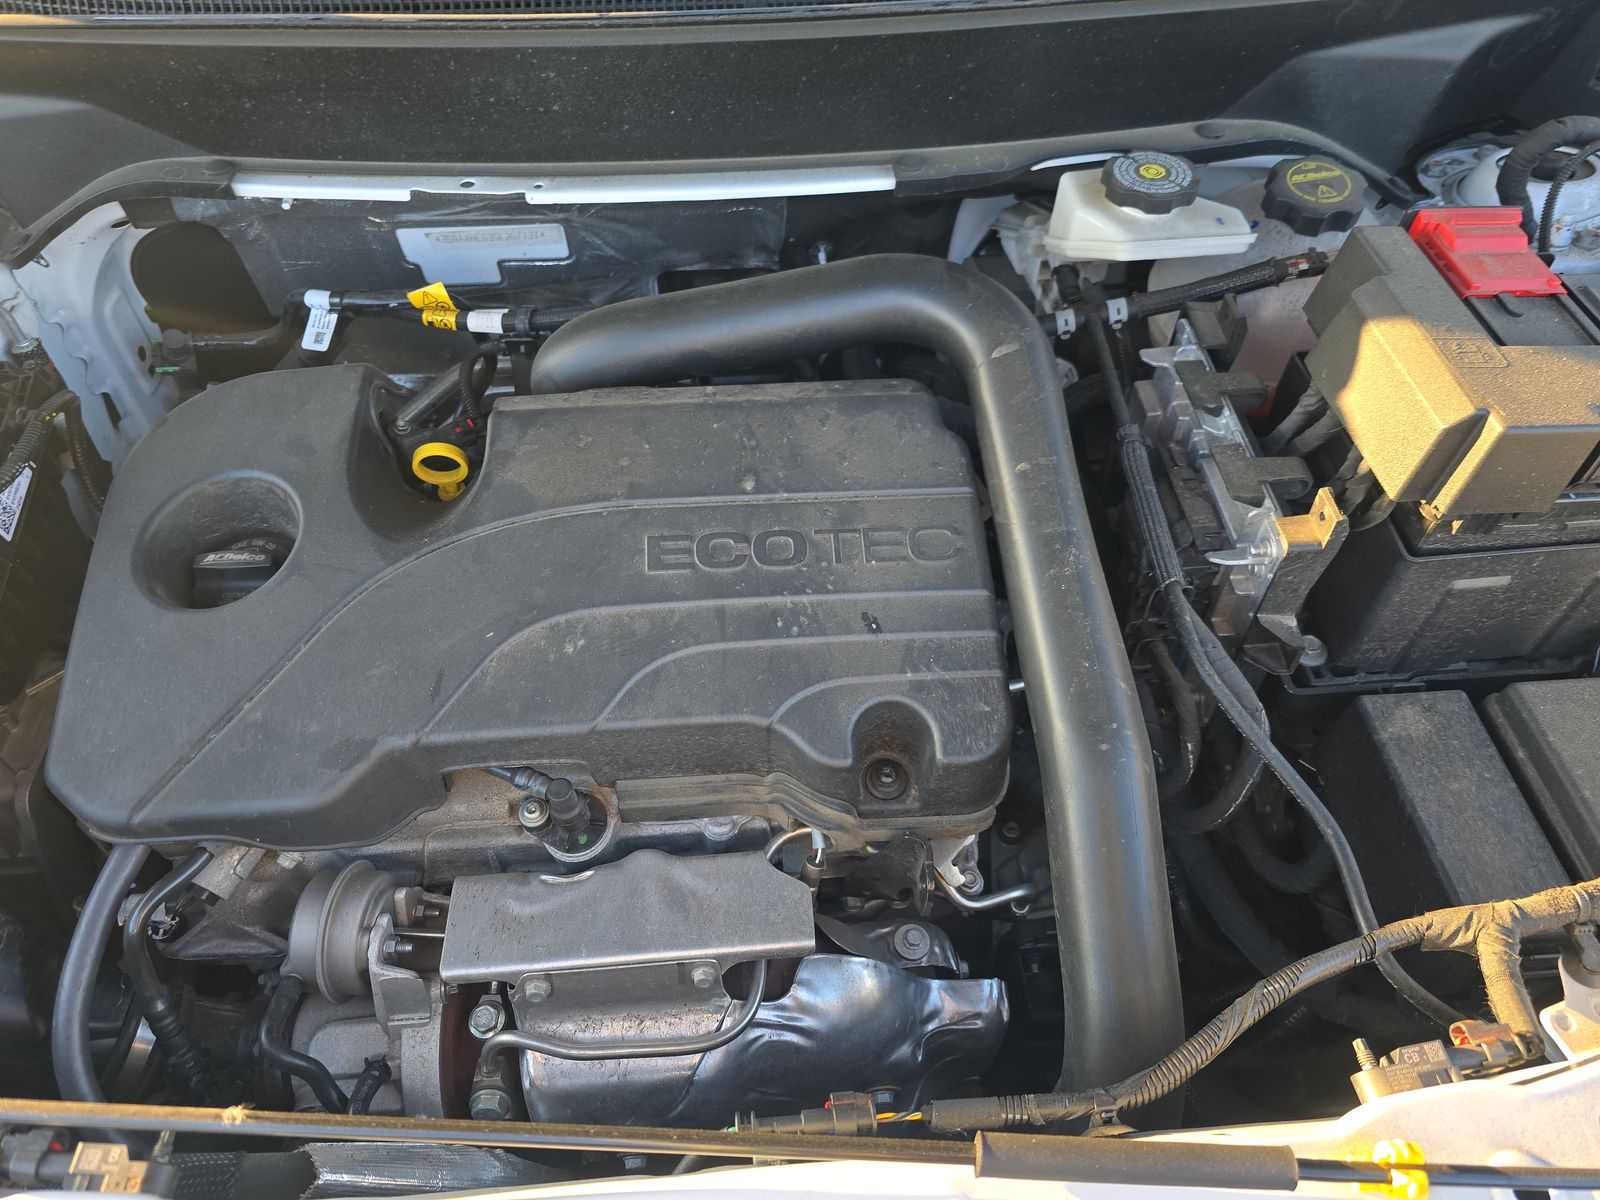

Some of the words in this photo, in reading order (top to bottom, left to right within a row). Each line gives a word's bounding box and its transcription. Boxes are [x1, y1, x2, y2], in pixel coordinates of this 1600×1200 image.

[643, 525, 964, 574] ECOTEC
[203, 552, 266, 563] ACDelco
[1404, 1052, 1420, 1064] CB
